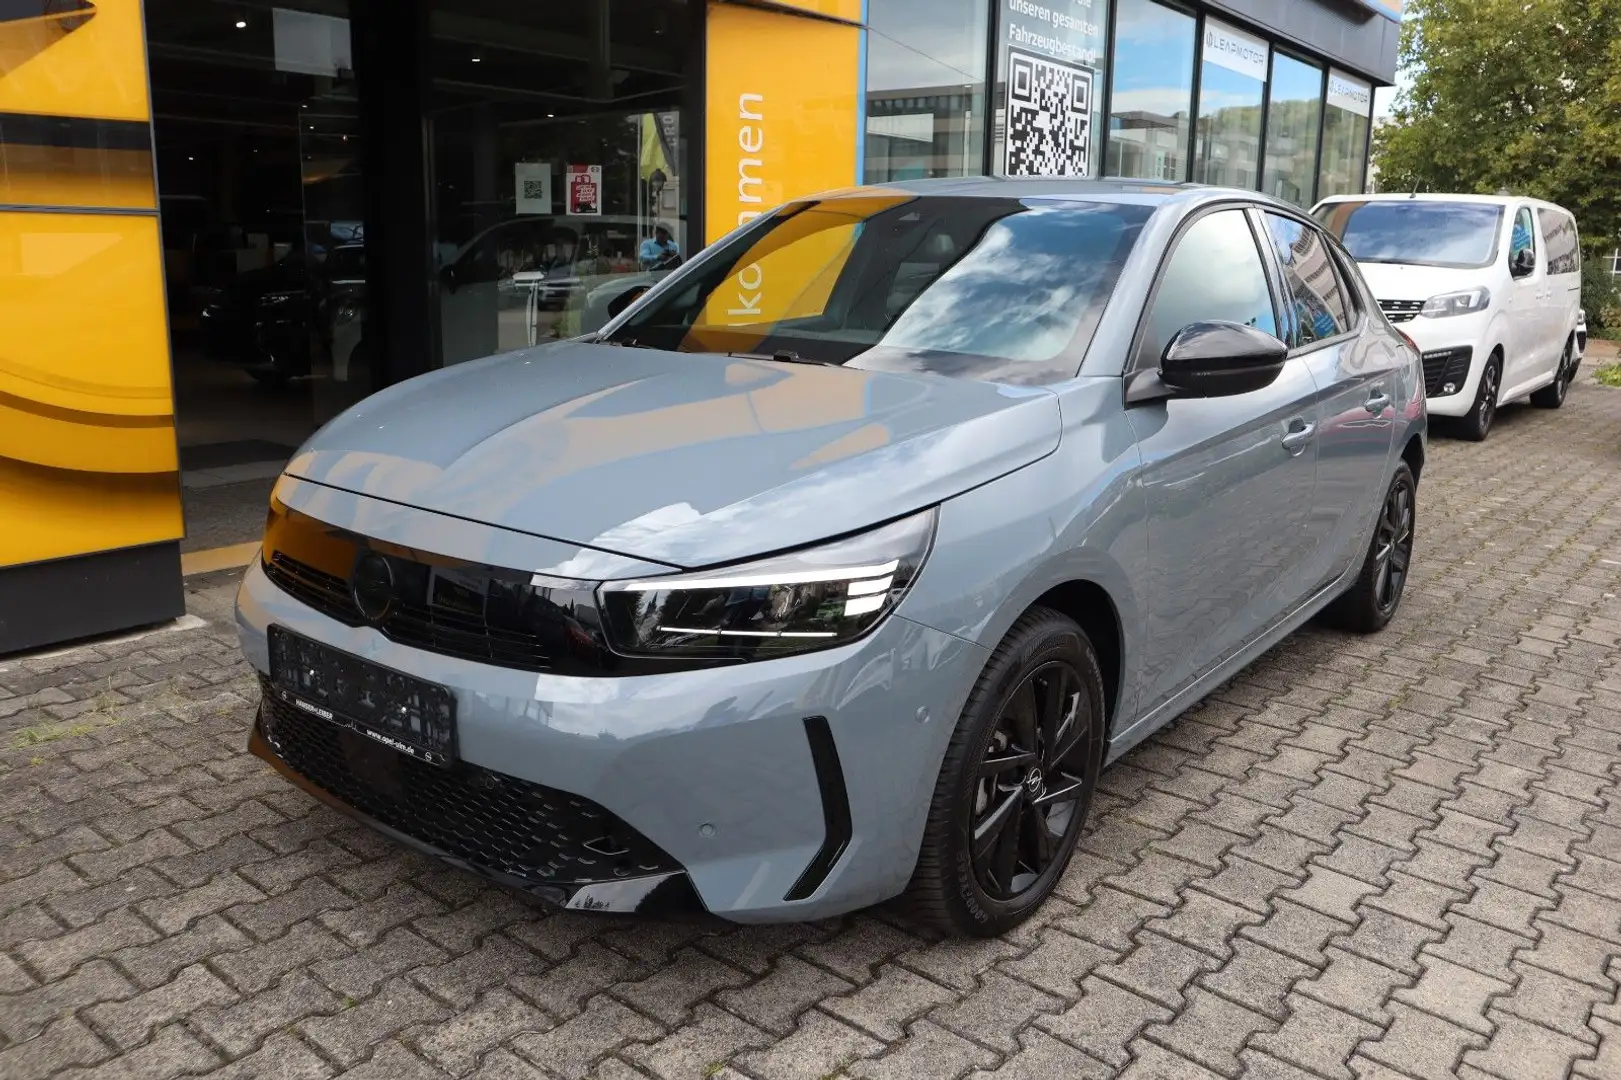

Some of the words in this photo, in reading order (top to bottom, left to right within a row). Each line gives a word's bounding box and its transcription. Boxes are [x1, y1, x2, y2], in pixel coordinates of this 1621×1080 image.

[1008, 0, 1051, 21] unseren
[1052, 11, 1099, 36] gesamten
[1213, 35, 1265, 67] LEAPMOTOR
